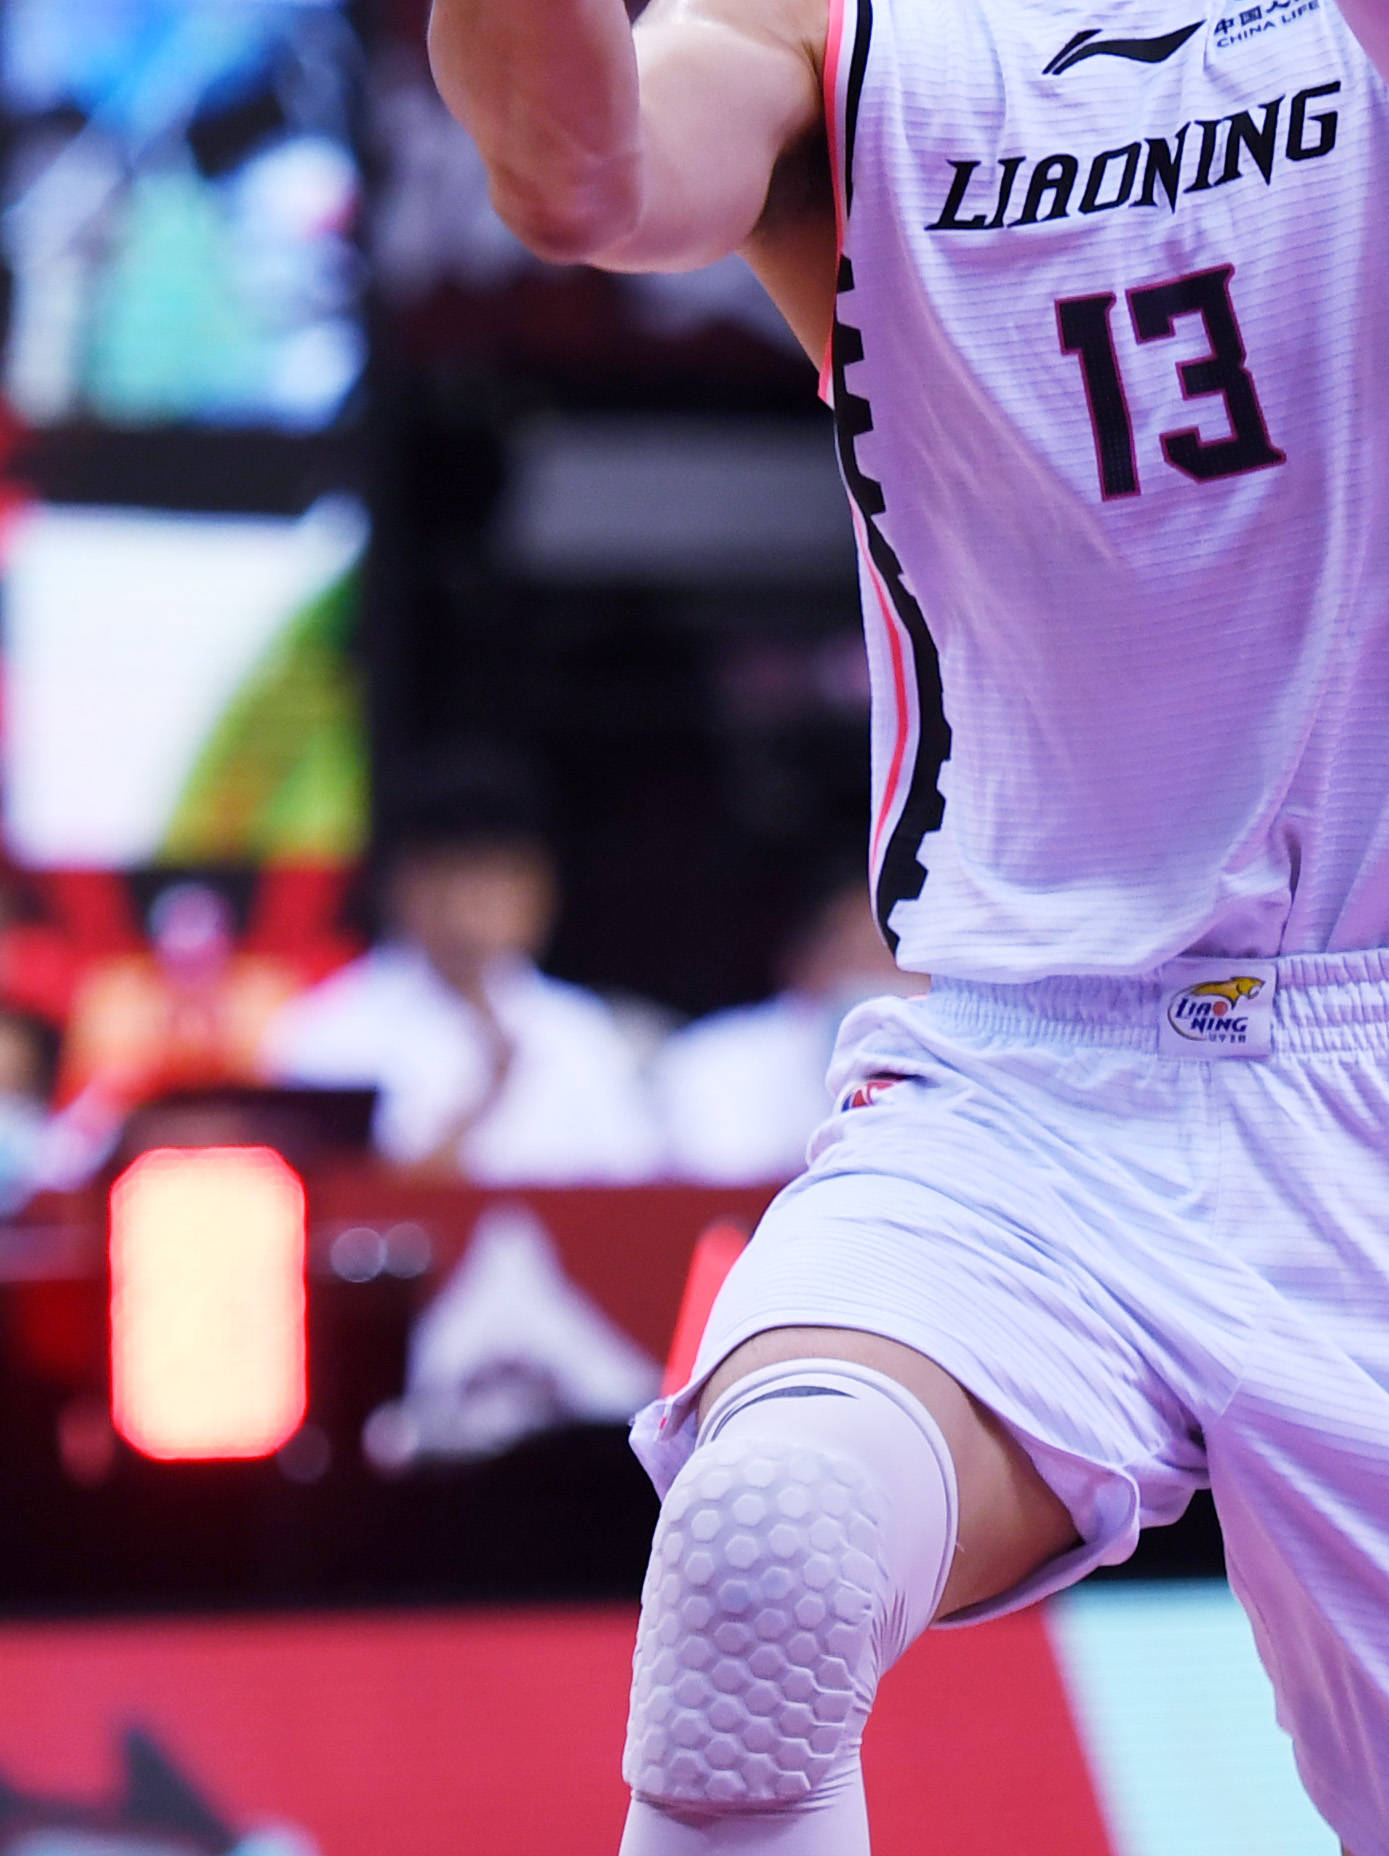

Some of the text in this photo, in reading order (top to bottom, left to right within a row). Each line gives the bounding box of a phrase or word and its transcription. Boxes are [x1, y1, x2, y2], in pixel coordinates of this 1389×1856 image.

[1217, 0, 1319, 47] CHINA LIFE
[923, 80, 1342, 232] LIAONING
[1054, 262, 1287, 502] 13
[1191, 1017, 1248, 1033] NING
